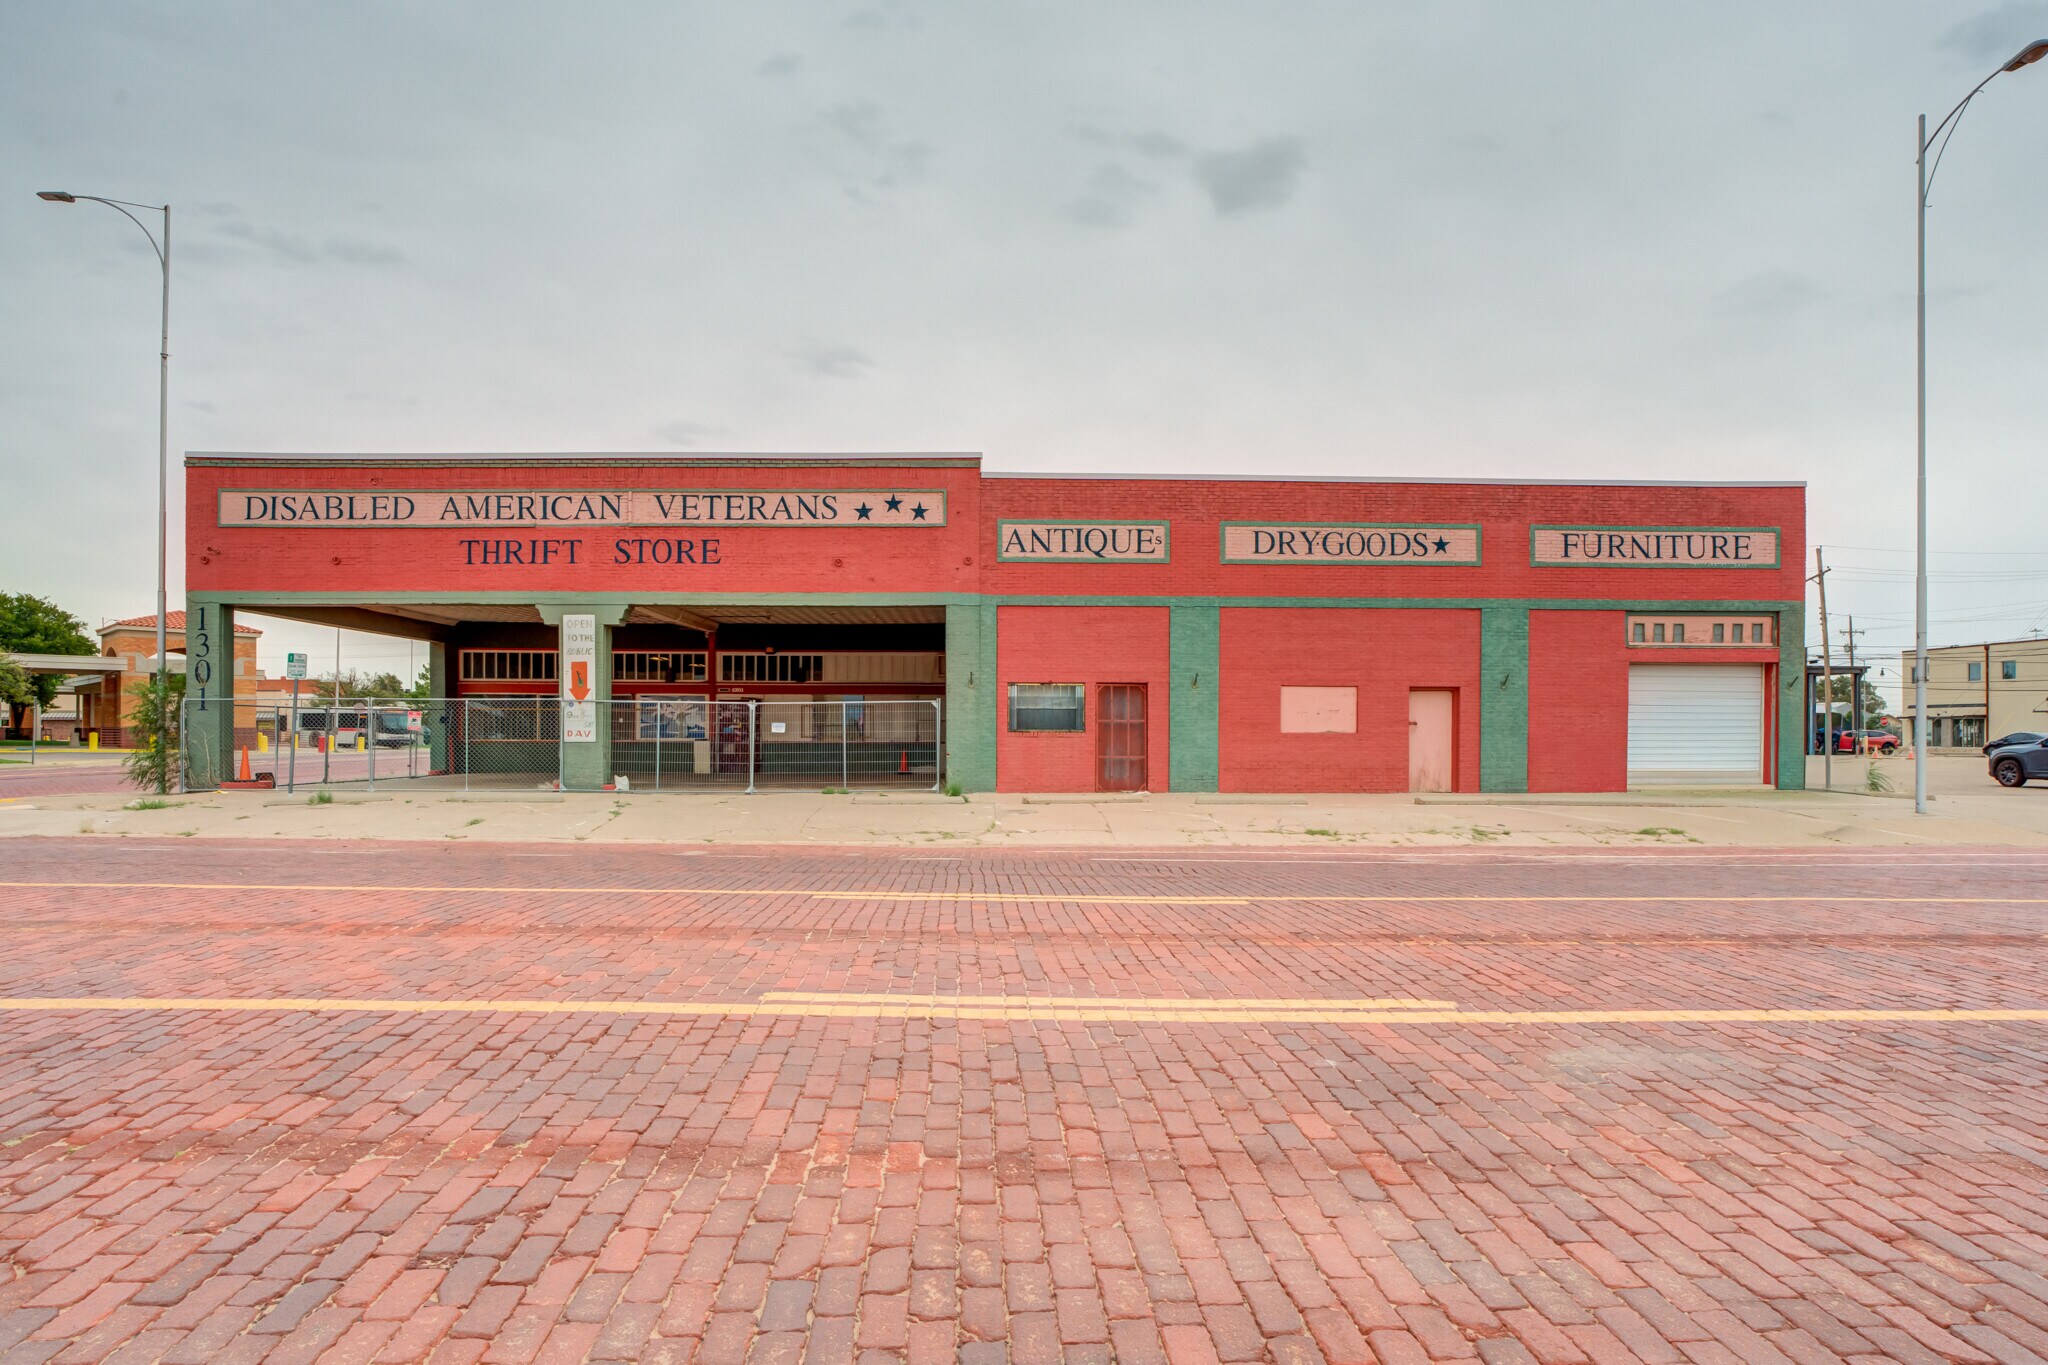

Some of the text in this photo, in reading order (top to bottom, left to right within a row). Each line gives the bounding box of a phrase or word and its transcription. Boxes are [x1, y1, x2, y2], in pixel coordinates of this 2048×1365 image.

[244, 495, 838, 521] DISABLED AMERICAN VETERANS
[460, 538, 722, 565] THRIFT STORE
[1560, 533, 1752, 560] FURNITURE
[566, 619, 593, 629] OPEN
[567, 634, 594, 642] TO THE
[195, 606, 211, 712] 1301
[566, 647, 593, 656] PUBLIC
